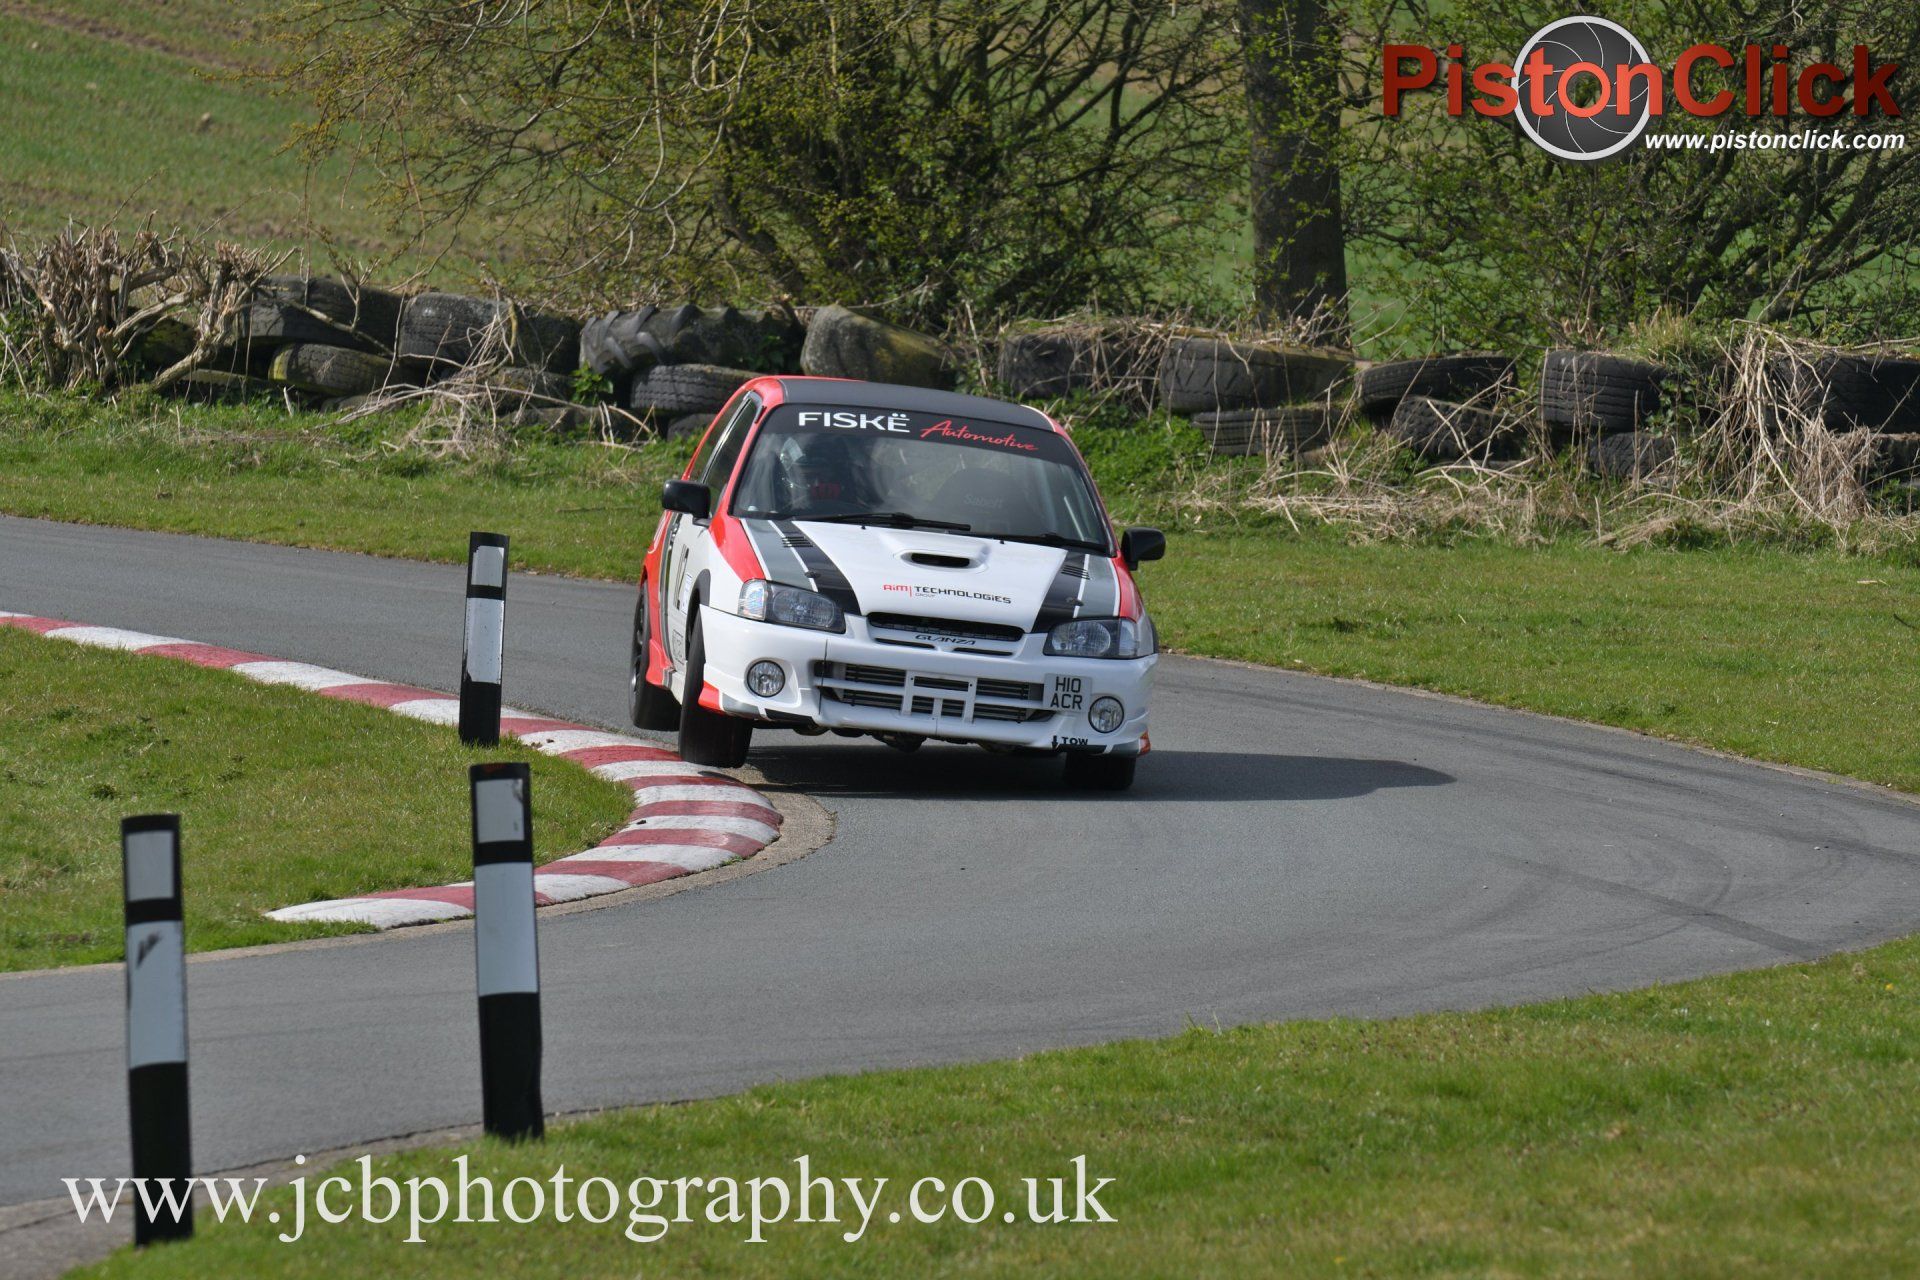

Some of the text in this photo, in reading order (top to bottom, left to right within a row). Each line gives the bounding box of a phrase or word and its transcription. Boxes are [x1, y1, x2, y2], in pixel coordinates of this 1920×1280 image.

[798, 411, 1039, 451] FISKË Automotive
[915, 634, 976, 646] GLANZA
[1050, 693, 1083, 710] ACR
[1061, 736, 1088, 746] TOW
